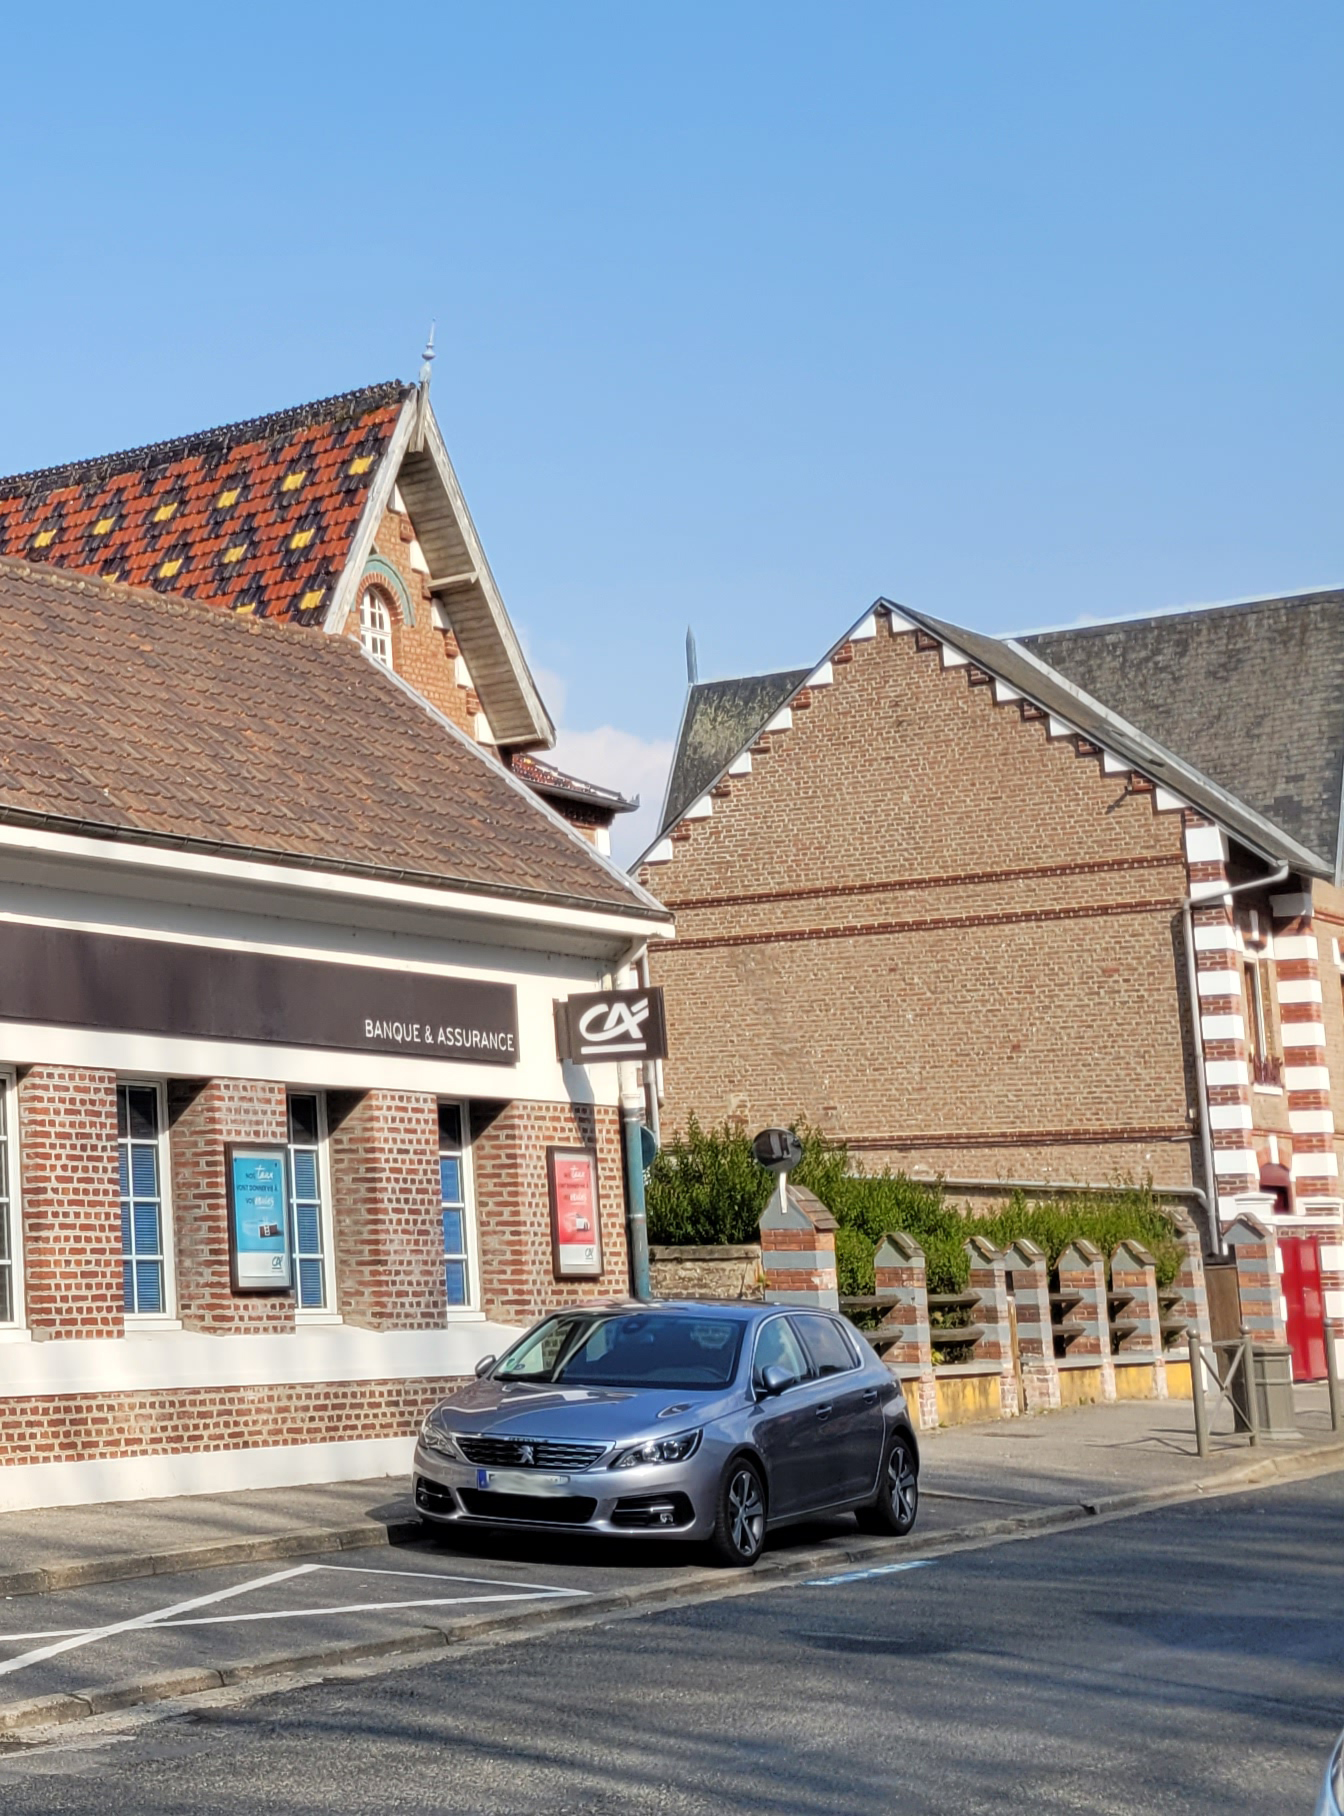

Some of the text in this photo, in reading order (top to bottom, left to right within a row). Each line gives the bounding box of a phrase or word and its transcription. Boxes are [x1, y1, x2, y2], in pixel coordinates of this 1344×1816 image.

[365, 1019, 515, 1051] BANQUE & ASSURANCE
